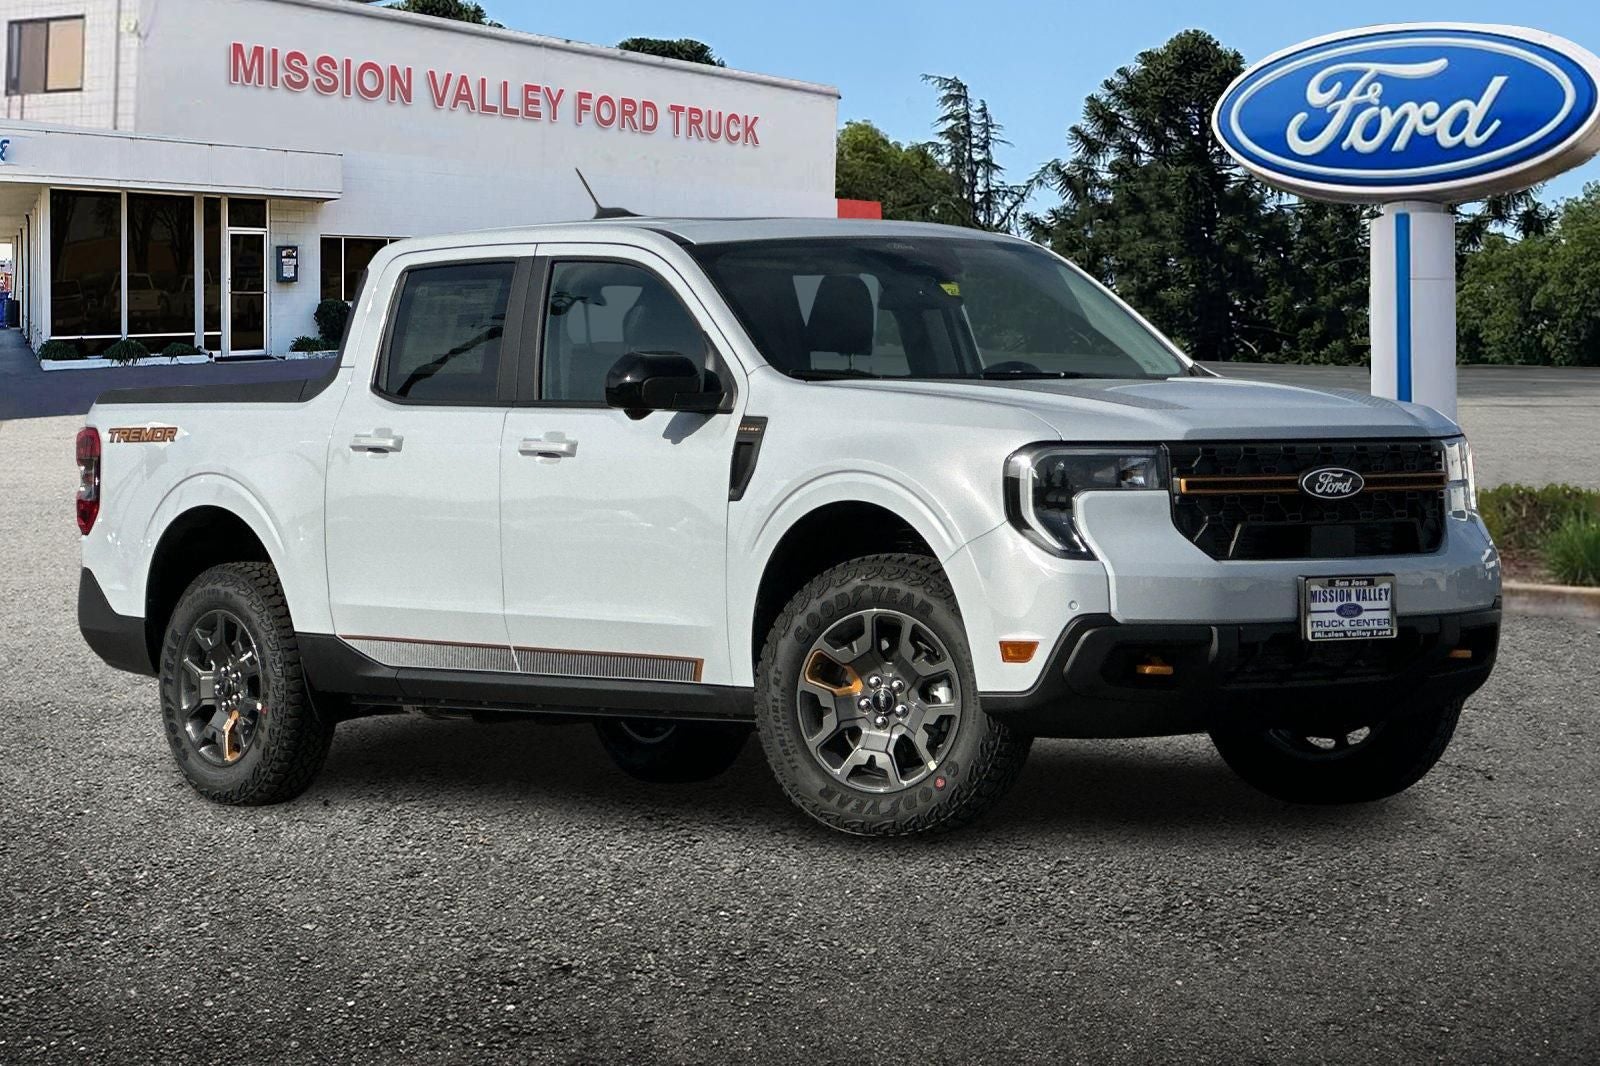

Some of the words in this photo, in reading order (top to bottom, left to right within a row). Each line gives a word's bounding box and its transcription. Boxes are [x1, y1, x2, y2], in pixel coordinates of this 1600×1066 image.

[230, 41, 414, 105] MISSION
[426, 69, 565, 123] VALLEY
[575, 90, 659, 134] FORD
[668, 104, 760, 147] TRUCK
[1286, 58, 1509, 156] Ford
[108, 426, 178, 443] TREMOR
[1315, 472, 1353, 493] Ford
[1334, 579, 1349, 587] San
[1351, 579, 1368, 587] Jose
[1310, 588, 1352, 603] MISSION
[1355, 587, 1391, 602] VALLEY
[1310, 620, 1346, 629] TRUCK
[1349, 618, 1391, 627] CENTER
[1314, 630, 1344, 638] Mission
[1346, 629, 1371, 638] Valley
[1373, 628, 1392, 637] Ford
[818, 761, 960, 817] GODYEAR
